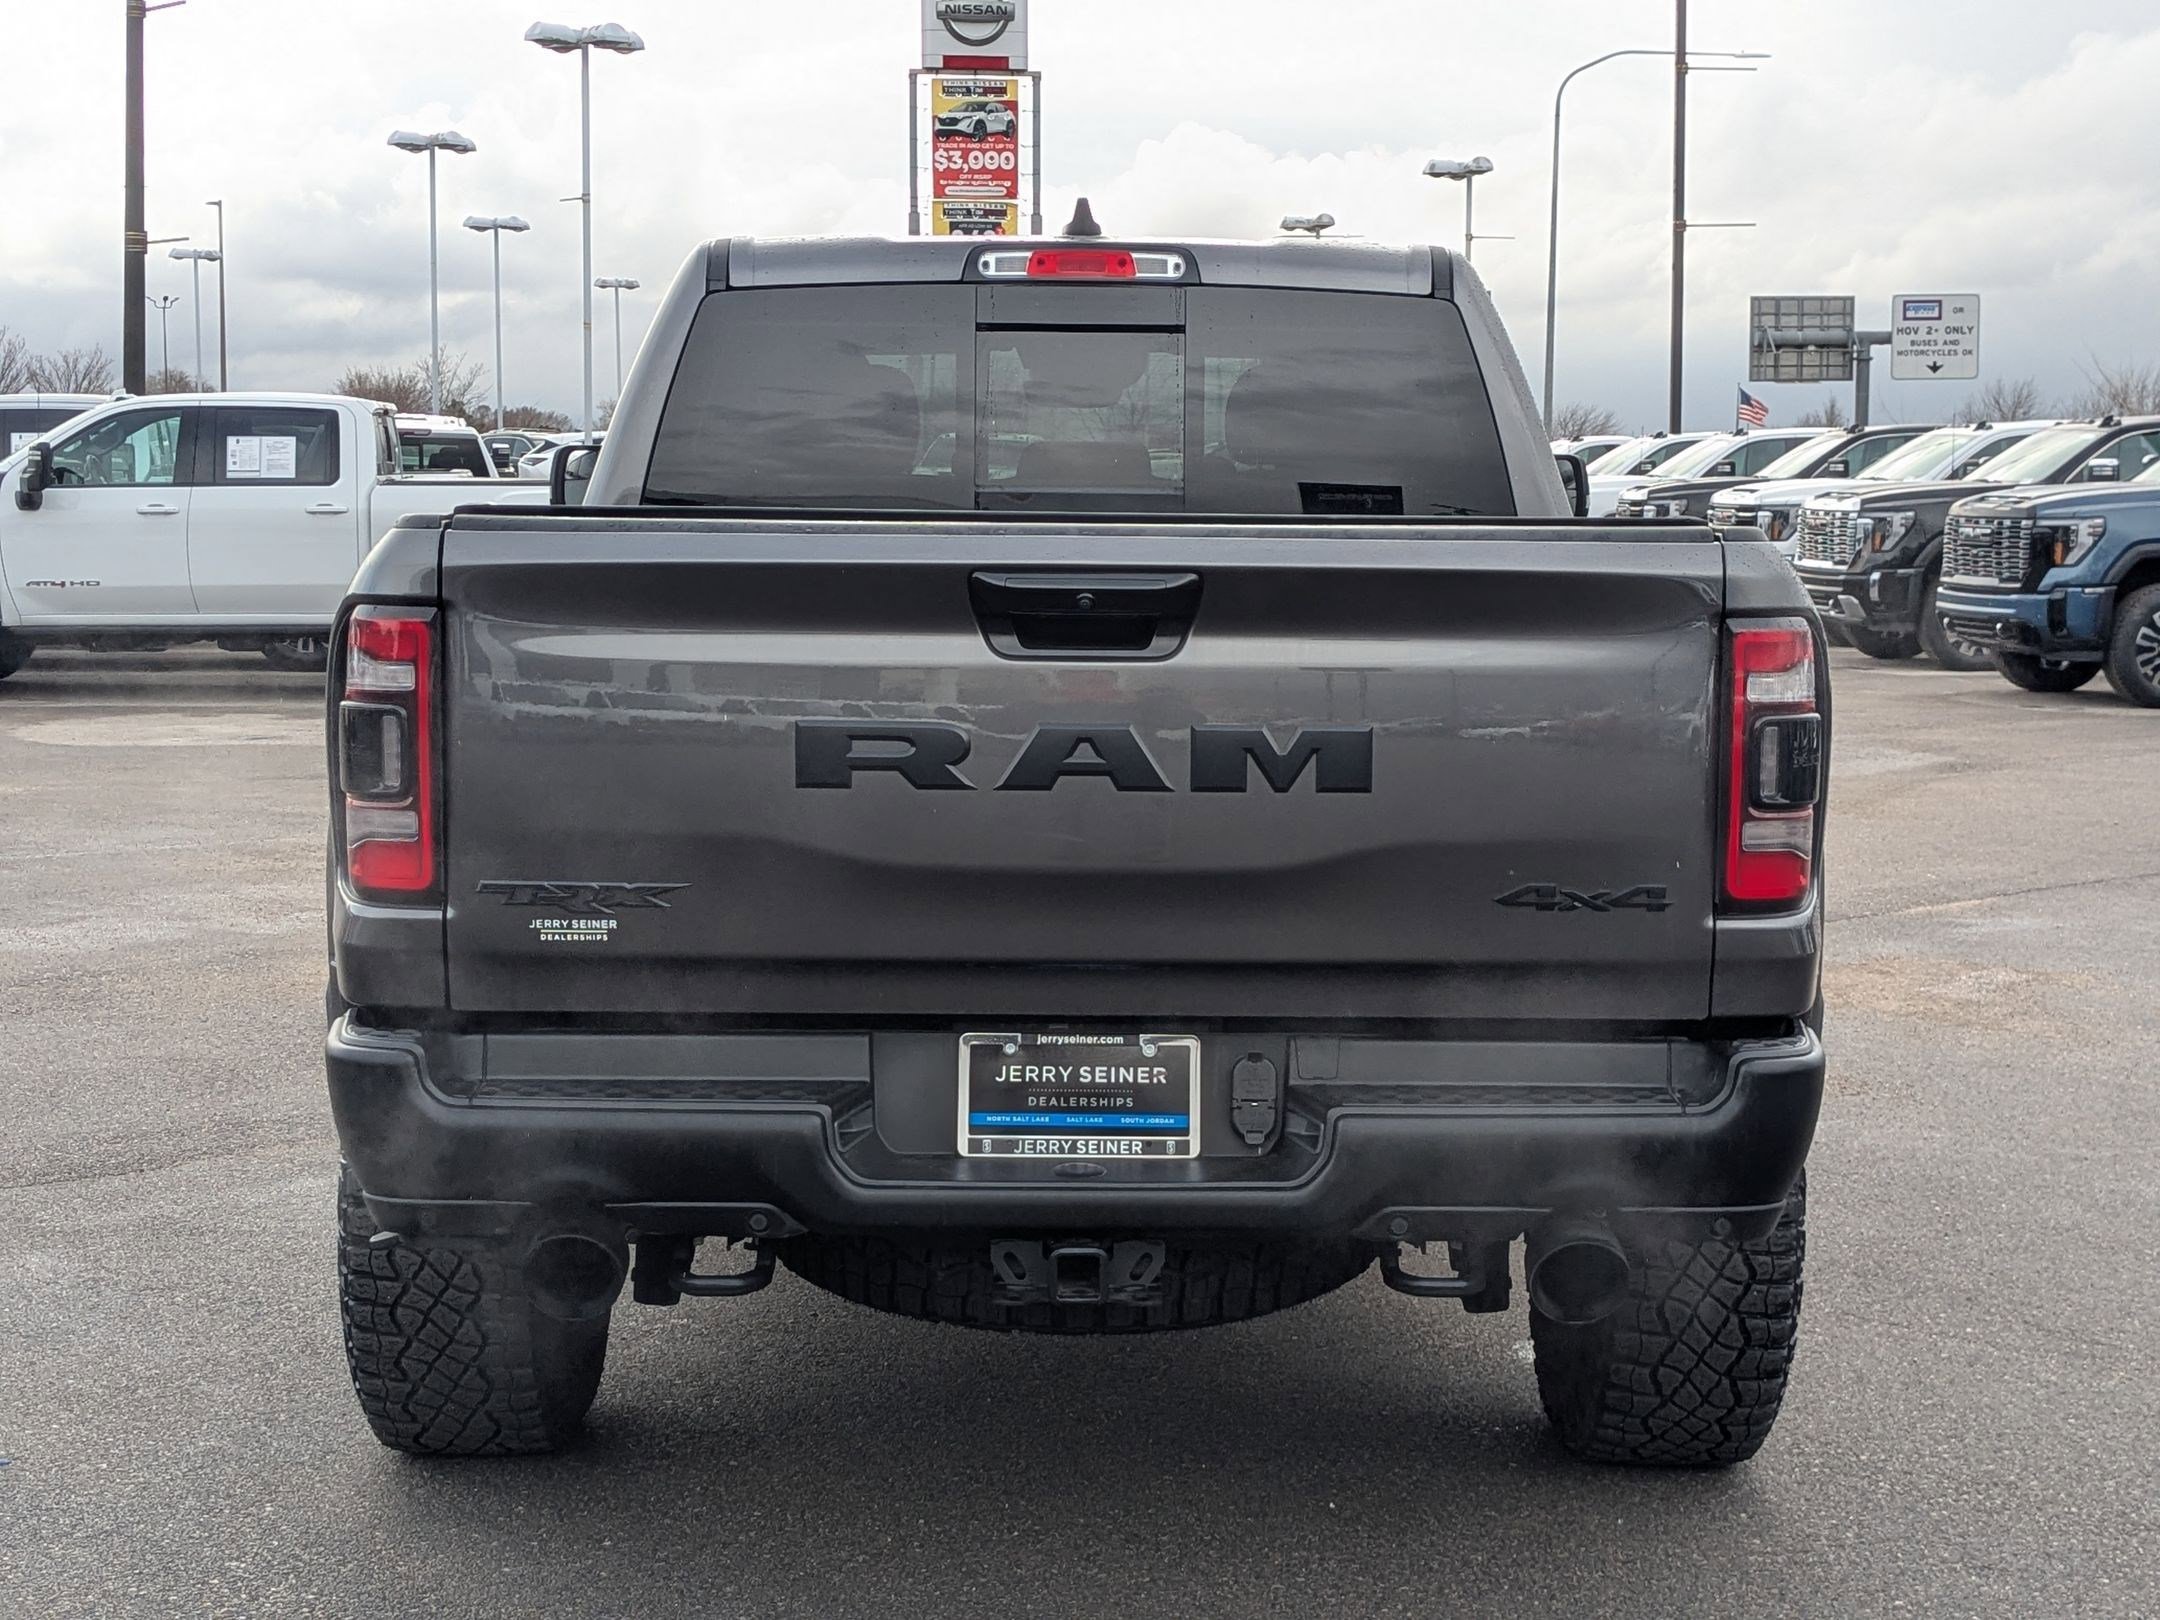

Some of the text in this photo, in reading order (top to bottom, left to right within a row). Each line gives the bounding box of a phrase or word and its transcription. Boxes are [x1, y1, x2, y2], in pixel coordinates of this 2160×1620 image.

[944, 4, 1008, 15] NISSAN
[1952, 306, 1965, 314] OR
[1896, 326, 1920, 336] HOV
[1944, 326, 1974, 335] ONLY
[1909, 339, 1960, 347] BUSES AND
[1896, 348, 1974, 357] MOTORCYCLES OK
[795, 719, 1373, 793] RAM
[528, 919, 618, 929] JERRY SEINER
[540, 933, 608, 941] DEALERSHIPS
[1037, 1034, 1124, 1045] jerryseiner.com
[995, 1065, 1168, 1084] JERRY SEINER
[1028, 1096, 1134, 1107] DEALERSHIPS
[1013, 1140, 1143, 1154] JERRY SEINER
